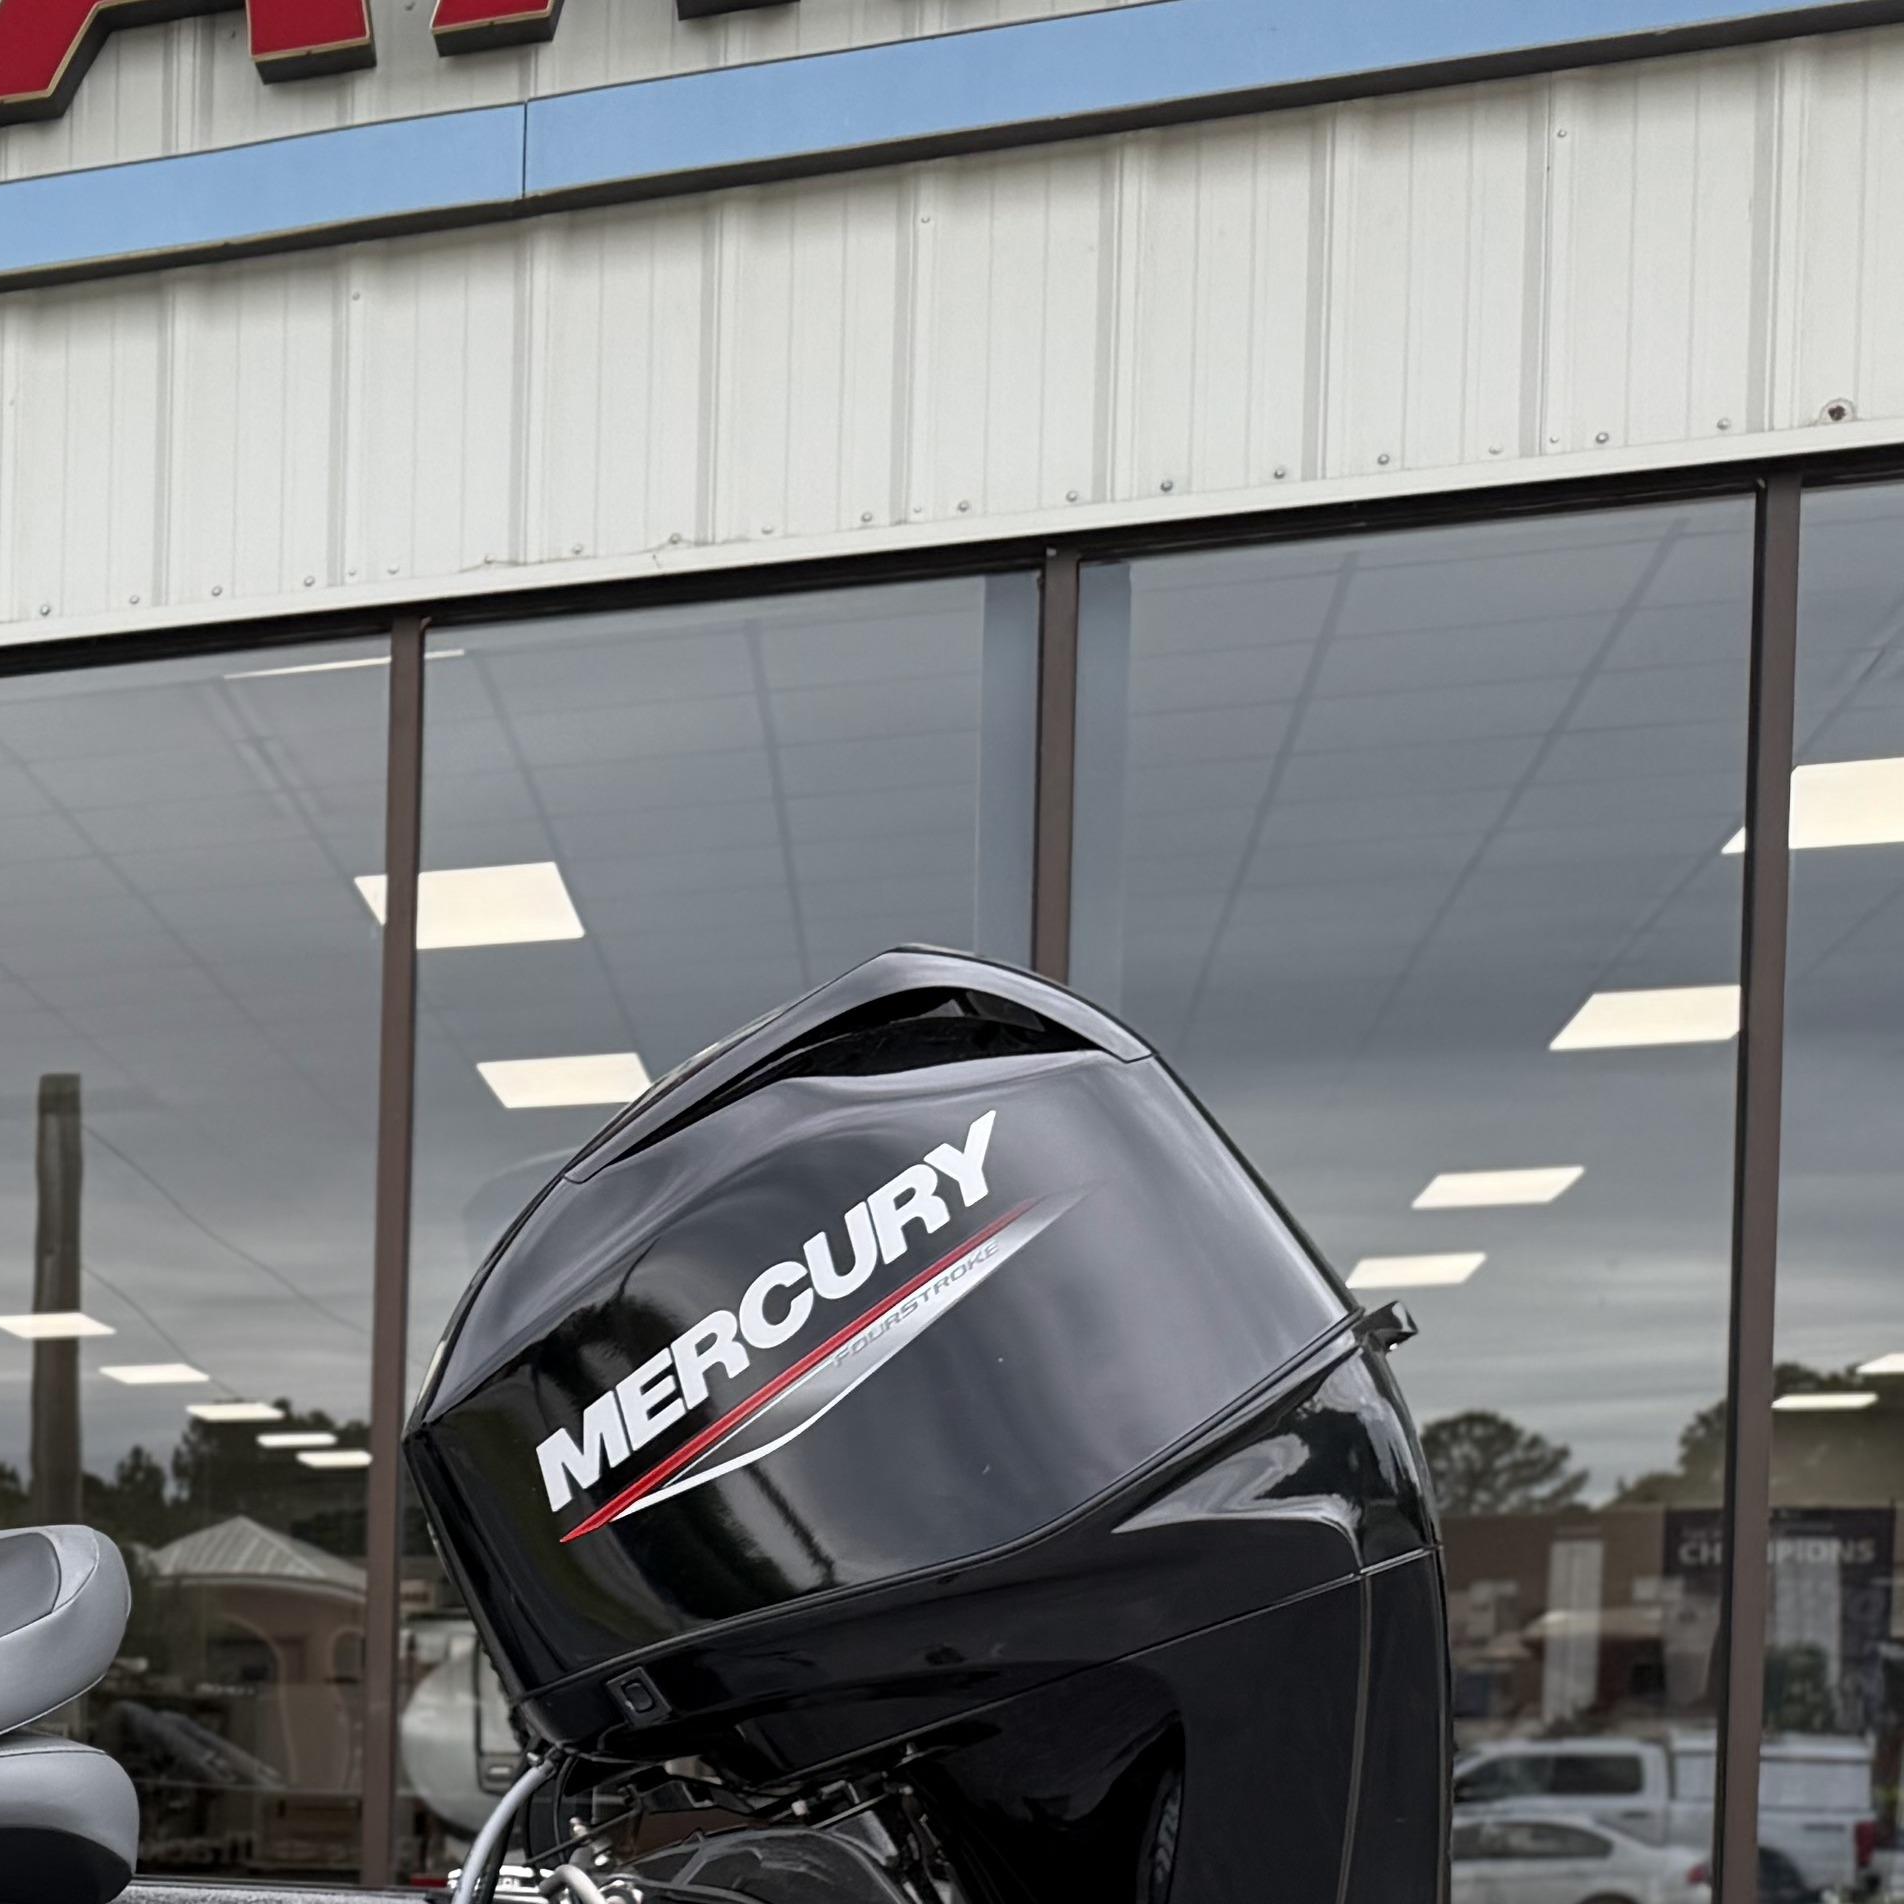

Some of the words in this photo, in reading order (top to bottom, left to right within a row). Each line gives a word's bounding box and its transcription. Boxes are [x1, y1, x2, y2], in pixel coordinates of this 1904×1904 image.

[535, 1110, 996, 1512] MERCURY
[832, 1239, 1000, 1368] FOURSTROKE
[1679, 1537, 1876, 1566] CHPIONS
